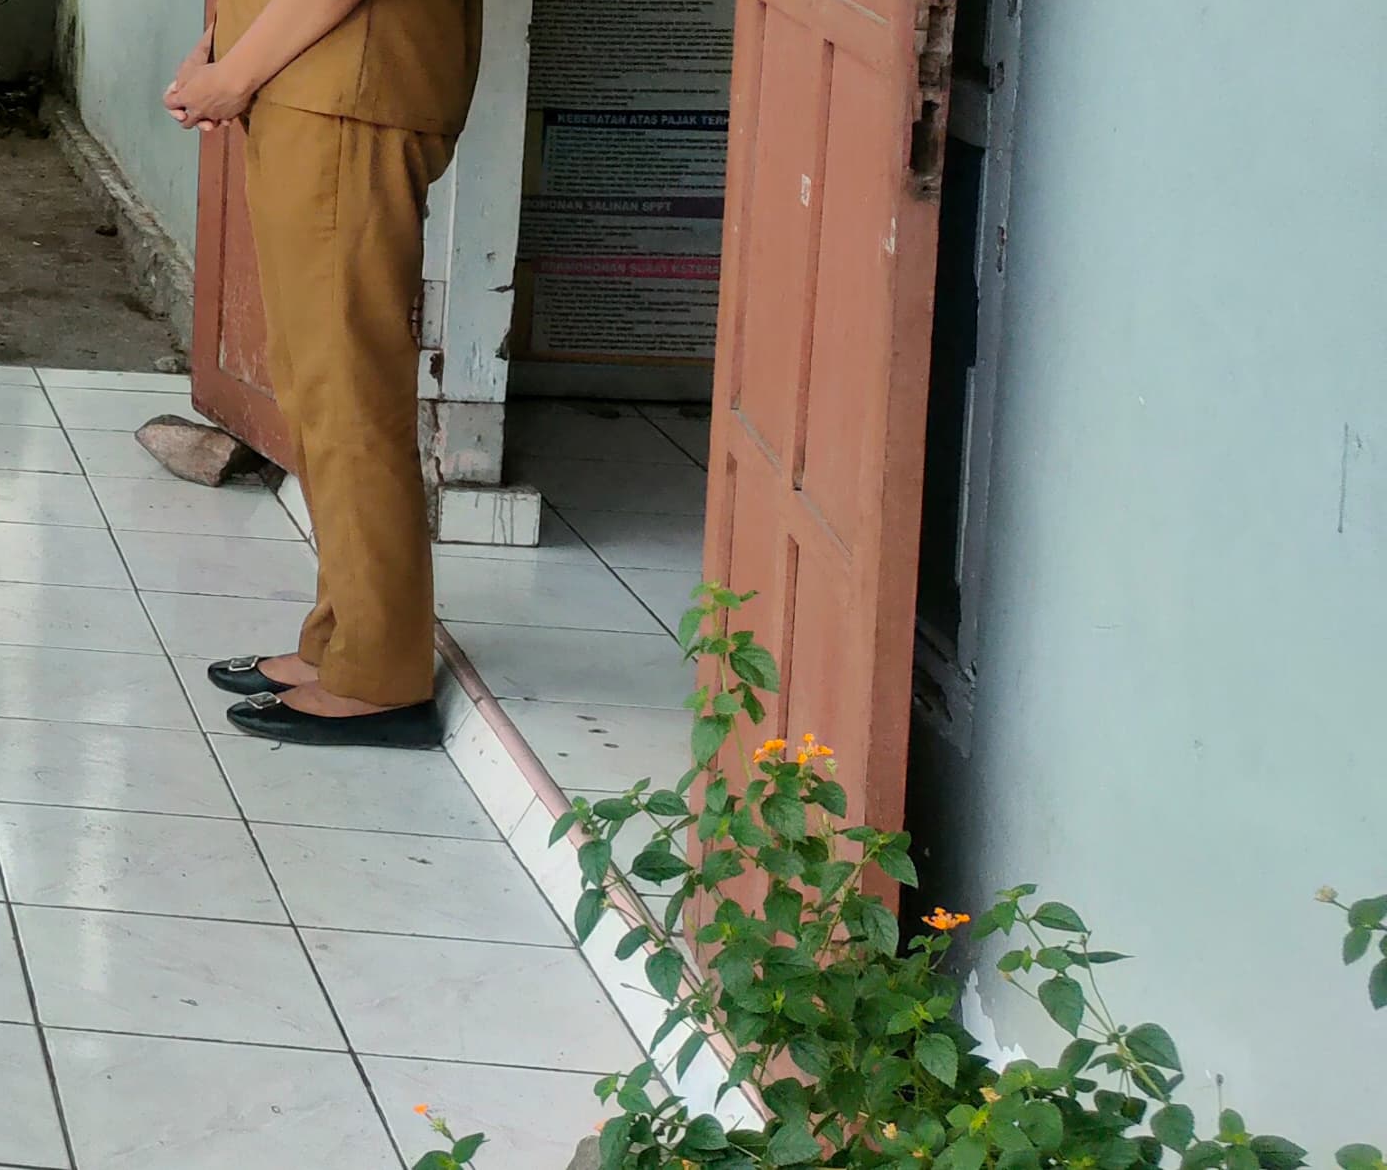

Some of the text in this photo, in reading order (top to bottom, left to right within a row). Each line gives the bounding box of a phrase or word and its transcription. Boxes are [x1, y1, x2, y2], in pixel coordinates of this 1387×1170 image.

[556, 112, 627, 125] KEBERATAN
[629, 114, 658, 125] ATAS
[660, 115, 697, 126] PAJAK
[586, 200, 639, 211] SALINAN
[642, 201, 672, 212] SPPT
